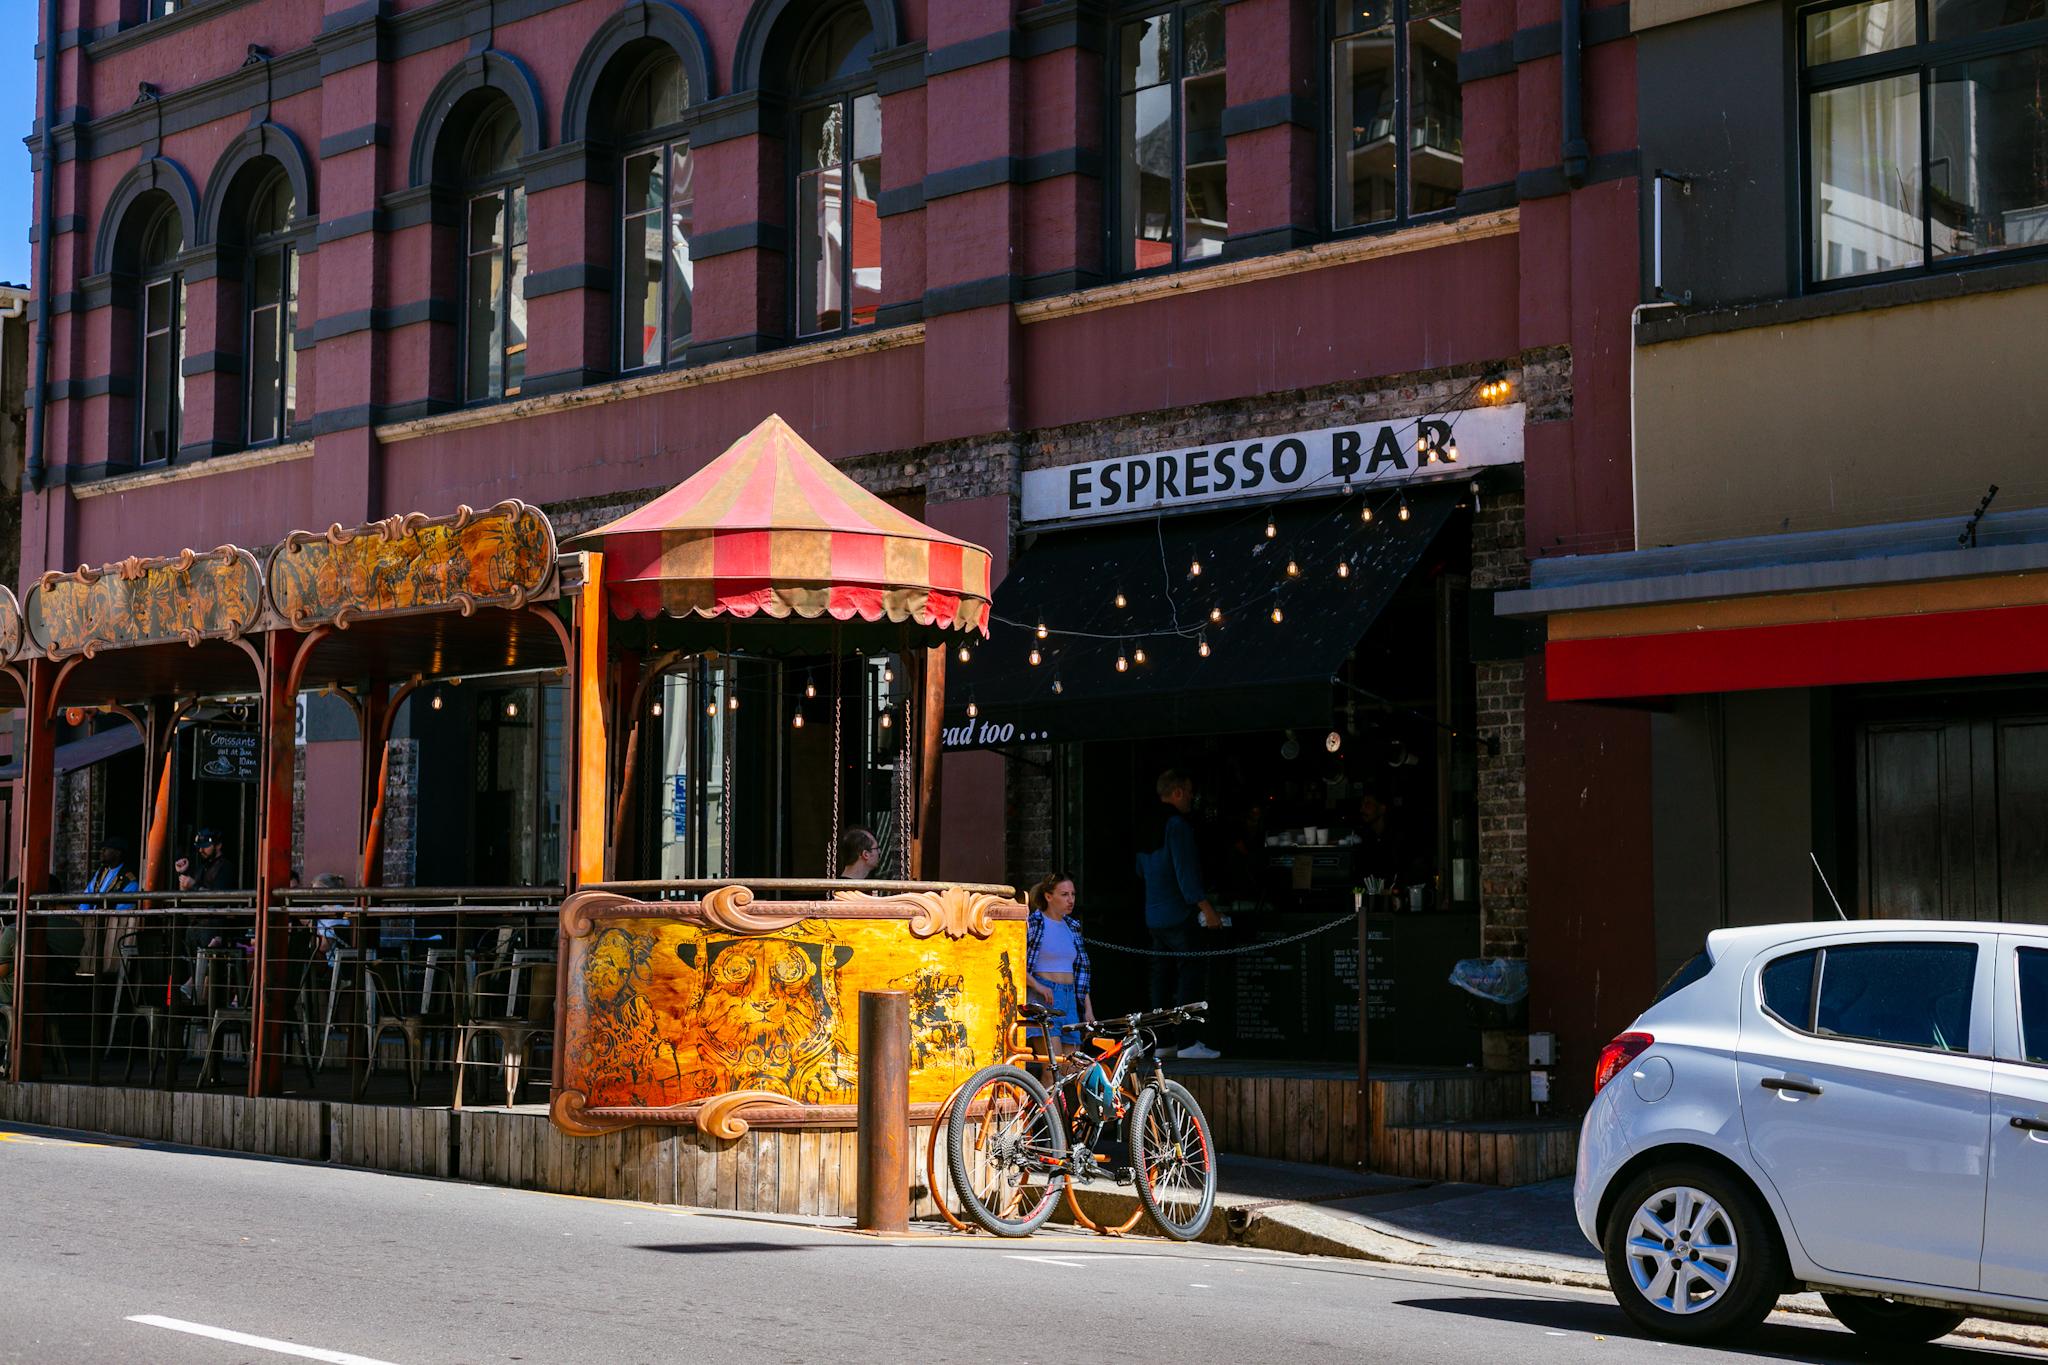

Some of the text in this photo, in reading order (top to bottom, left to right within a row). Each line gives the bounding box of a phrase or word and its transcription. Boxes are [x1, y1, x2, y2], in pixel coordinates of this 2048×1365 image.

[1069, 420, 1457, 510] ESPRESSO BAR
[210, 733, 256, 747] Croissants
[230, 748, 238, 756] at
